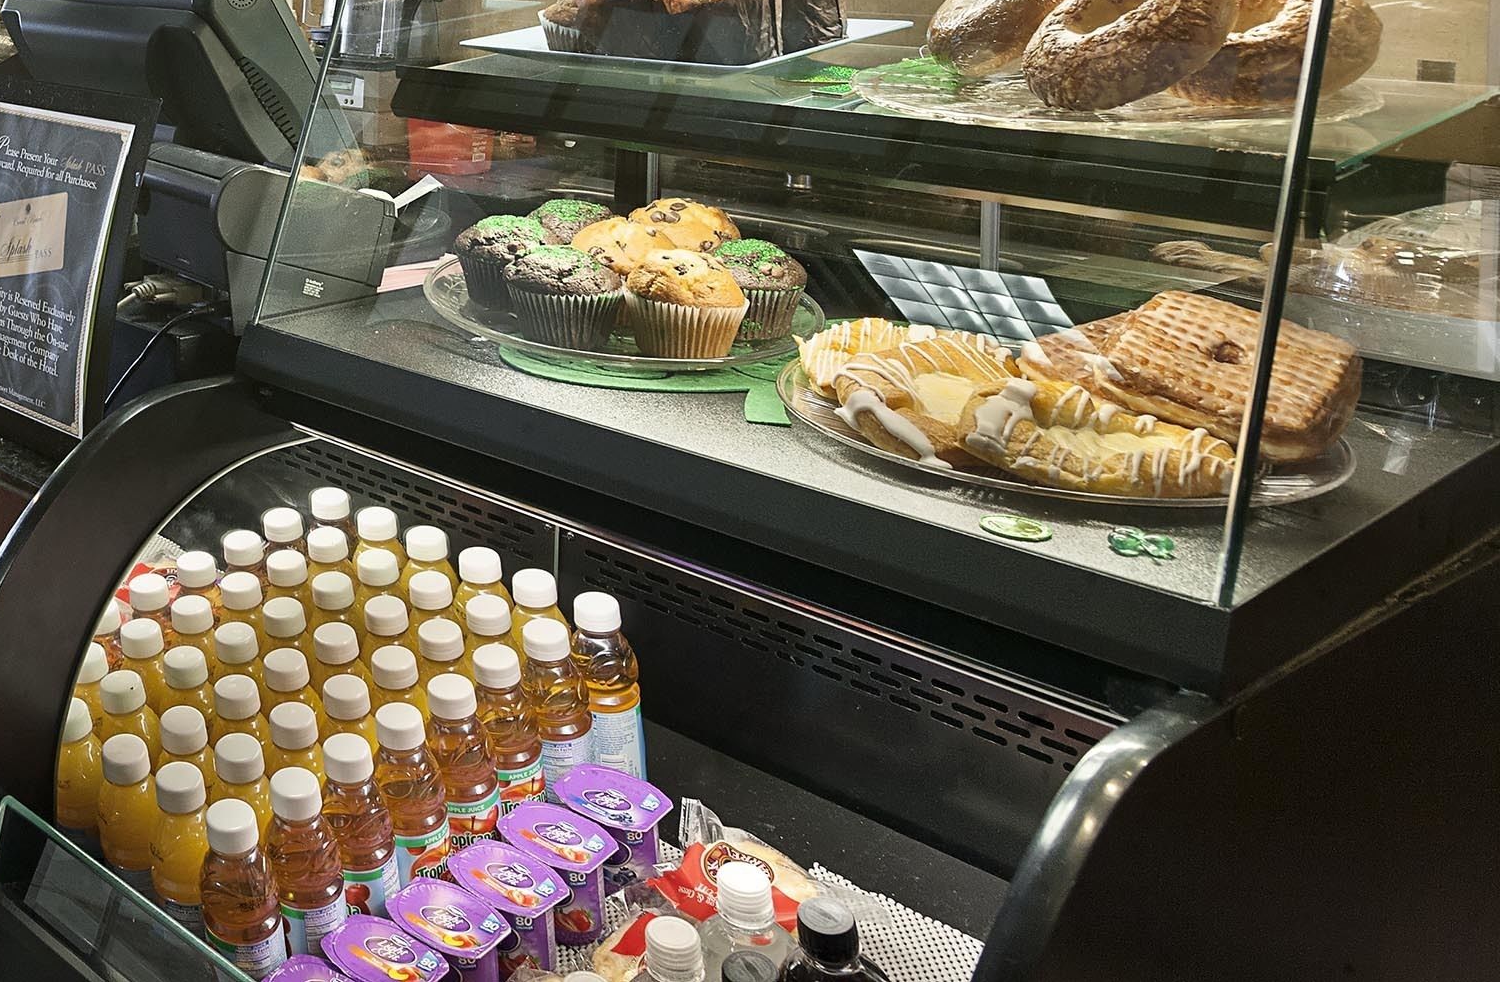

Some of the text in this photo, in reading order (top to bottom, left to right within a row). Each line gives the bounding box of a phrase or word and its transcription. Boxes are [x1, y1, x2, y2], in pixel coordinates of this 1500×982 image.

[20, 148, 42, 163] Present
[43, 152, 58, 166] Your
[85, 162, 107, 177] PASS
[16, 161, 45, 177] Required
[45, 167, 54, 179] for
[55, 170, 64, 182] all
[627, 831, 643, 841] 80
[569, 873, 586, 882] 80
[482, 921, 499, 931] 80
